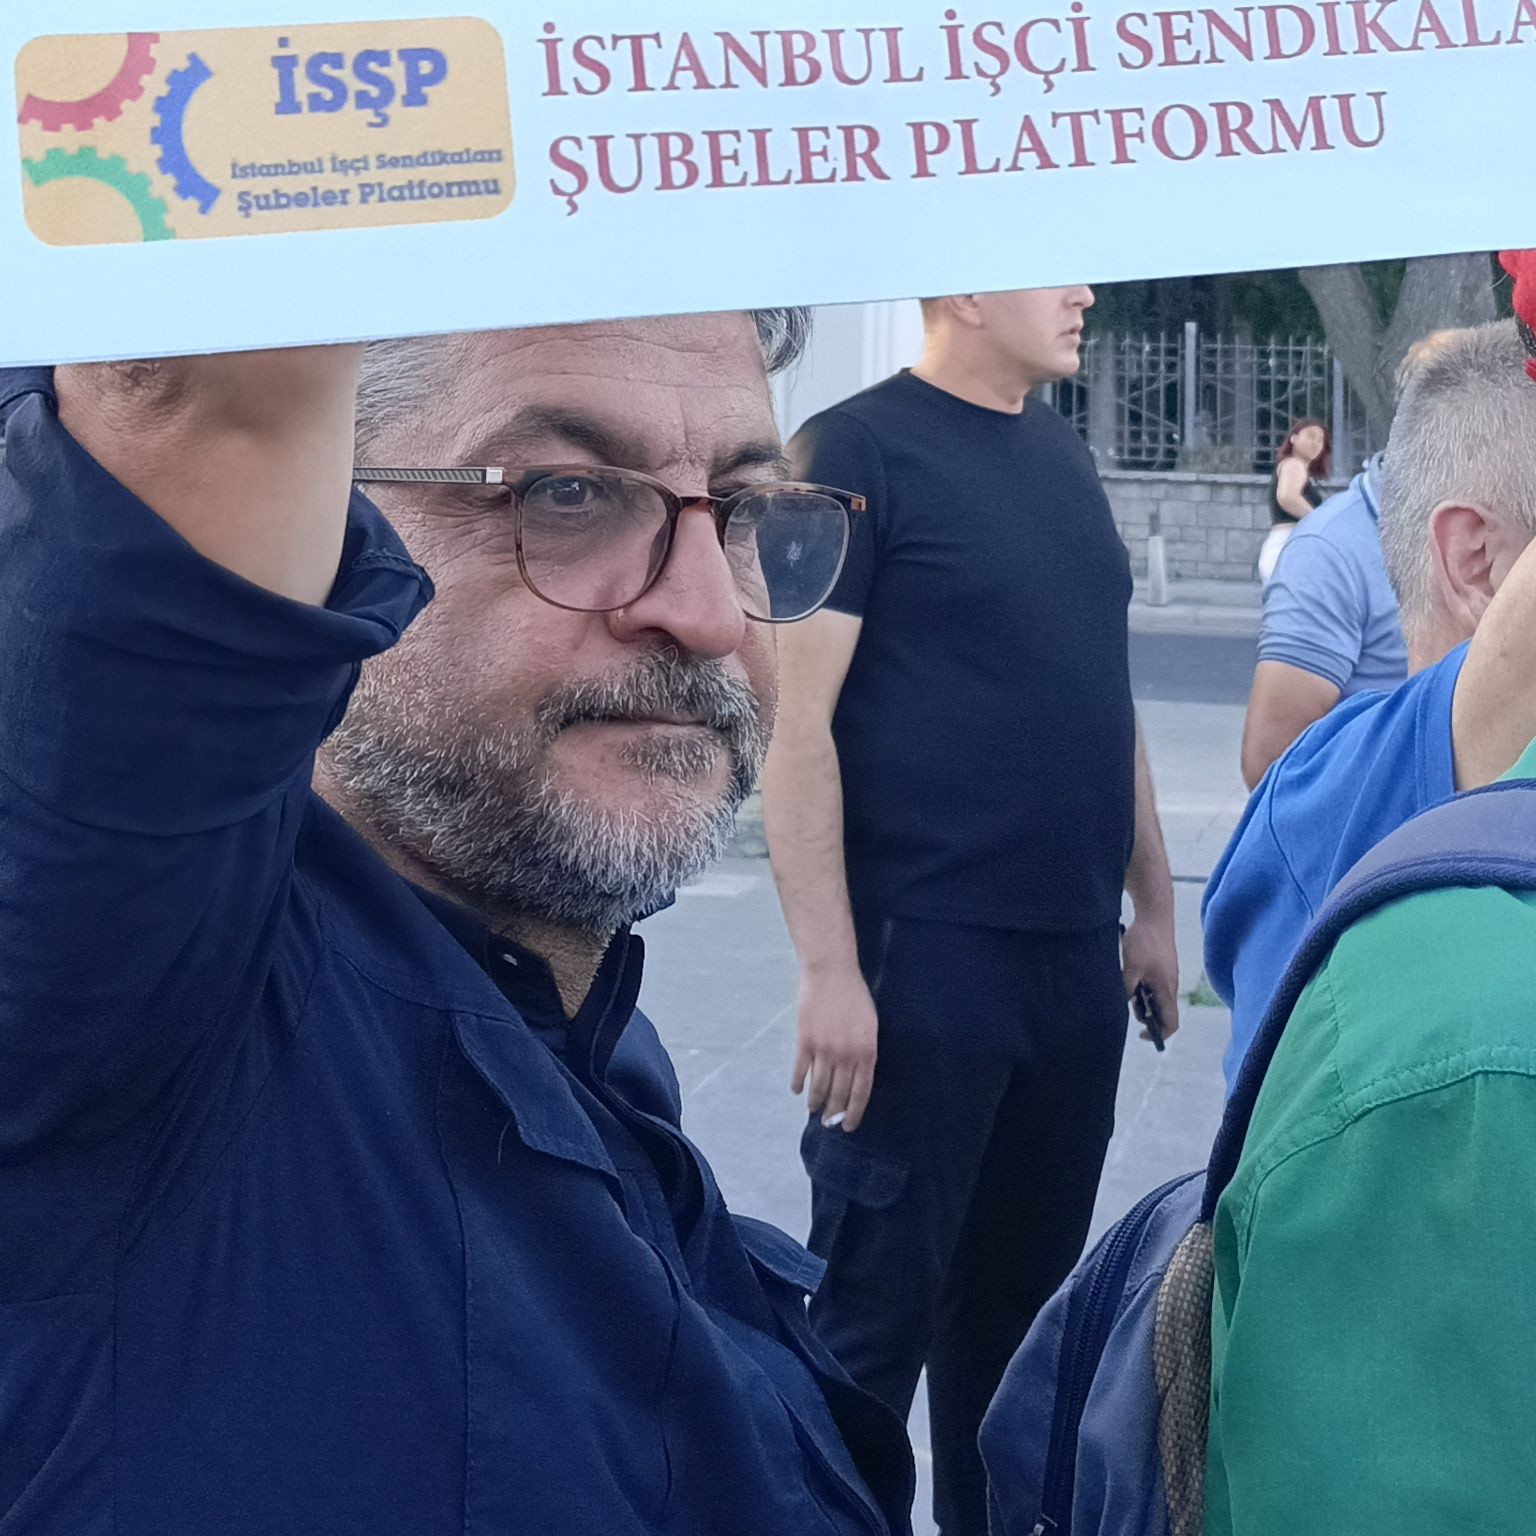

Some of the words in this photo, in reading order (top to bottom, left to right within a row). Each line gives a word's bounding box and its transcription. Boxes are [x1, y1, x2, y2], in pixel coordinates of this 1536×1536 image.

[270, 36, 449, 128] İSŞP
[536, 20, 925, 97] İSTANBUL
[938, 0, 1097, 98] İŞÇİ
[230, 154, 324, 180] İstanbul
[330, 152, 370, 177] İşçi
[236, 184, 350, 219] Şubeler
[357, 177, 503, 206] Platformu
[547, 124, 892, 217] ŞUBELER
[905, 90, 1388, 179] PLATFORMU
